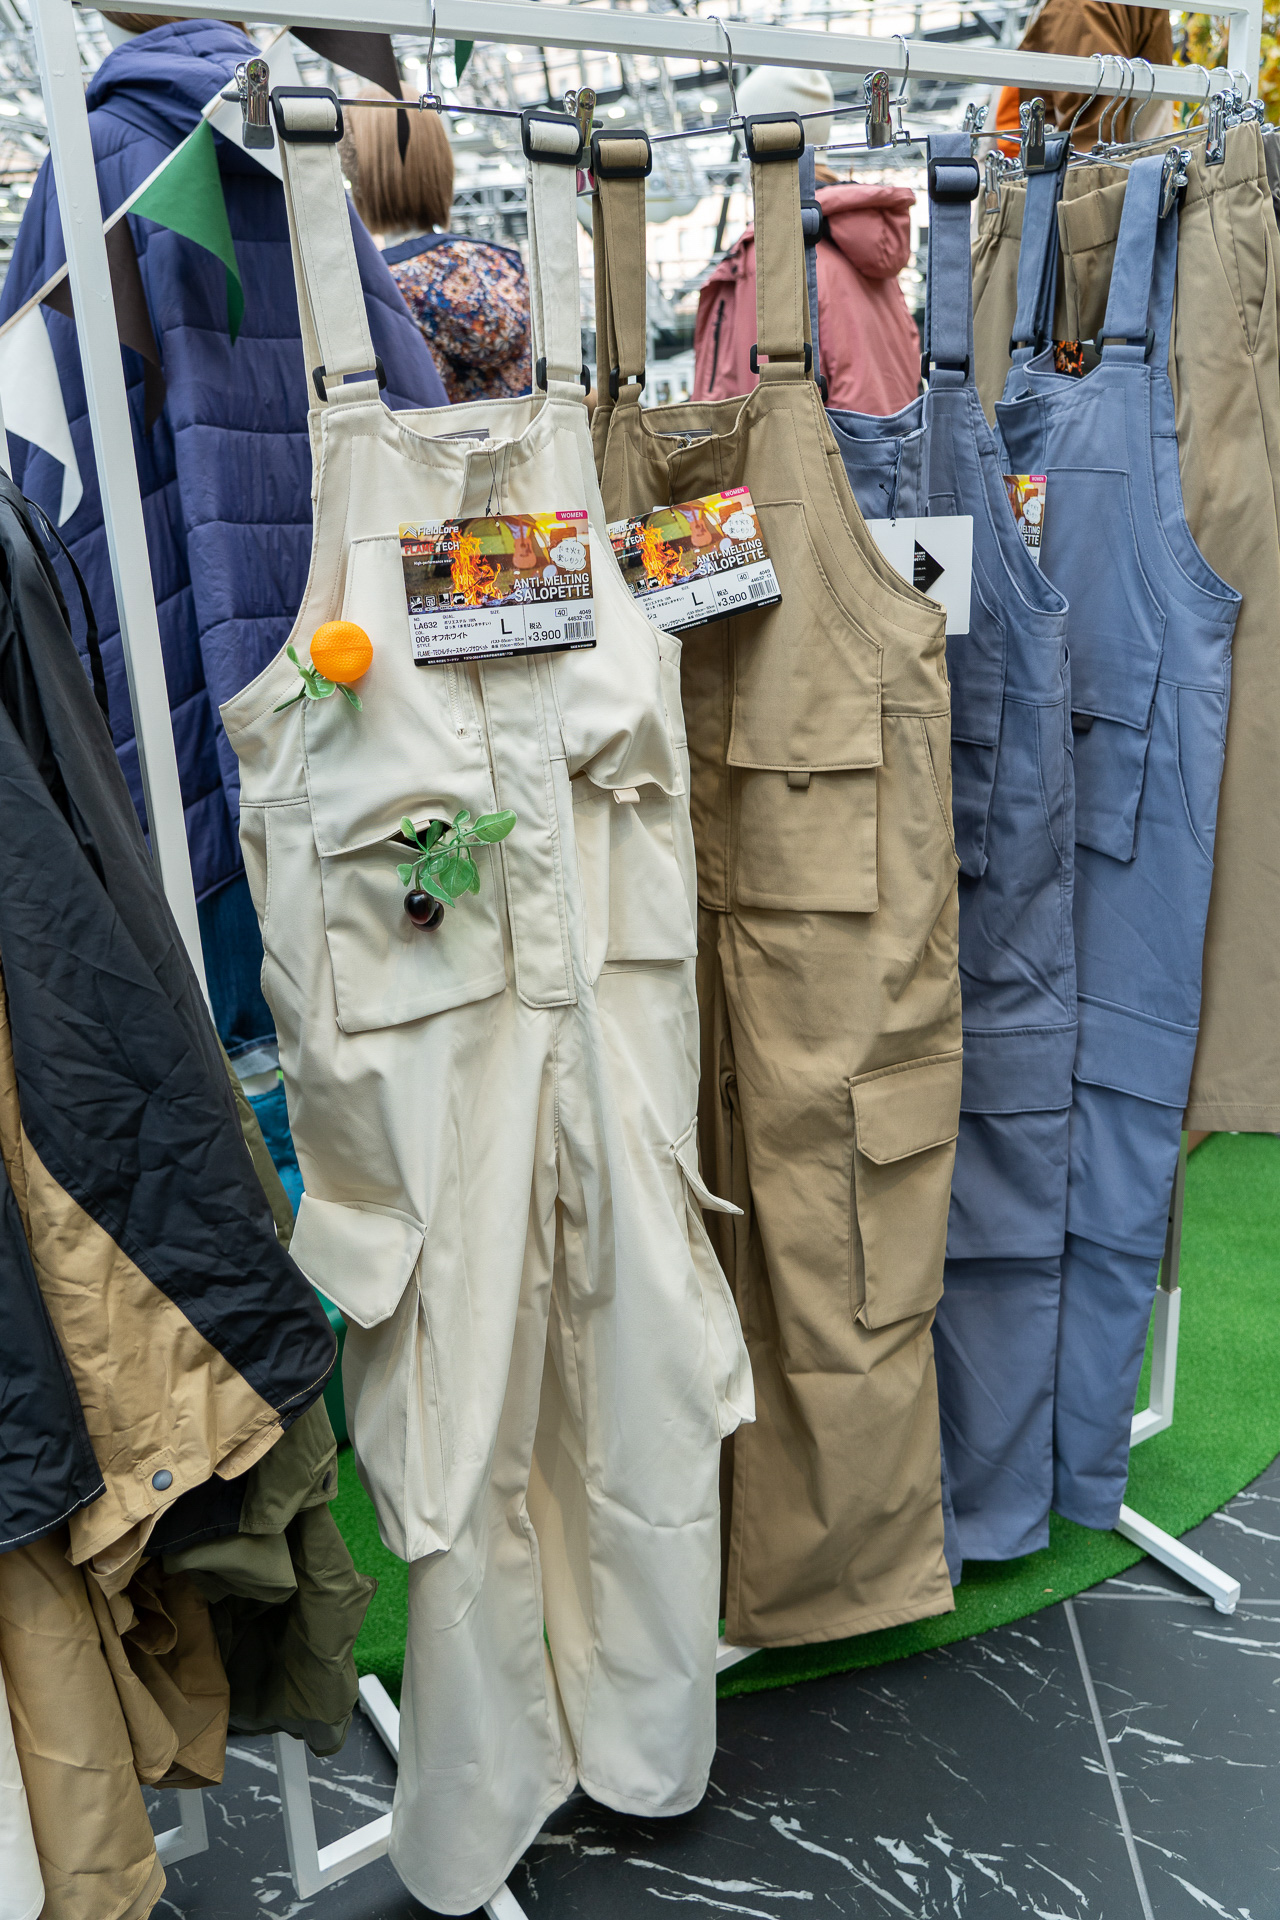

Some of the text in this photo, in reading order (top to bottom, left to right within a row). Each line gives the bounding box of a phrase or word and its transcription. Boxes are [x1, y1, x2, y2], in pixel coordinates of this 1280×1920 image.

[725, 487, 745, 497] WOMEN
[560, 511, 584, 519] WOMEN
[417, 525, 459, 536] FieldCore
[625, 533, 645, 546] TECH
[403, 541, 460, 554] FLAME TECH
[696, 538, 763, 566] ANTI-MELTING
[699, 547, 766, 576] SALOPETTE
[513, 572, 590, 590] ANTI-MELTING
[514, 583, 590, 602] SALOPETTE
[717, 591, 748, 607] ¥3,900
[691, 592, 704, 607] L
[413, 621, 438, 630] LA632
[500, 618, 513, 635] L
[529, 621, 542, 630] 税込
[415, 631, 468, 643] 006 オフホワイト
[527, 629, 561, 642] ¥3,900
